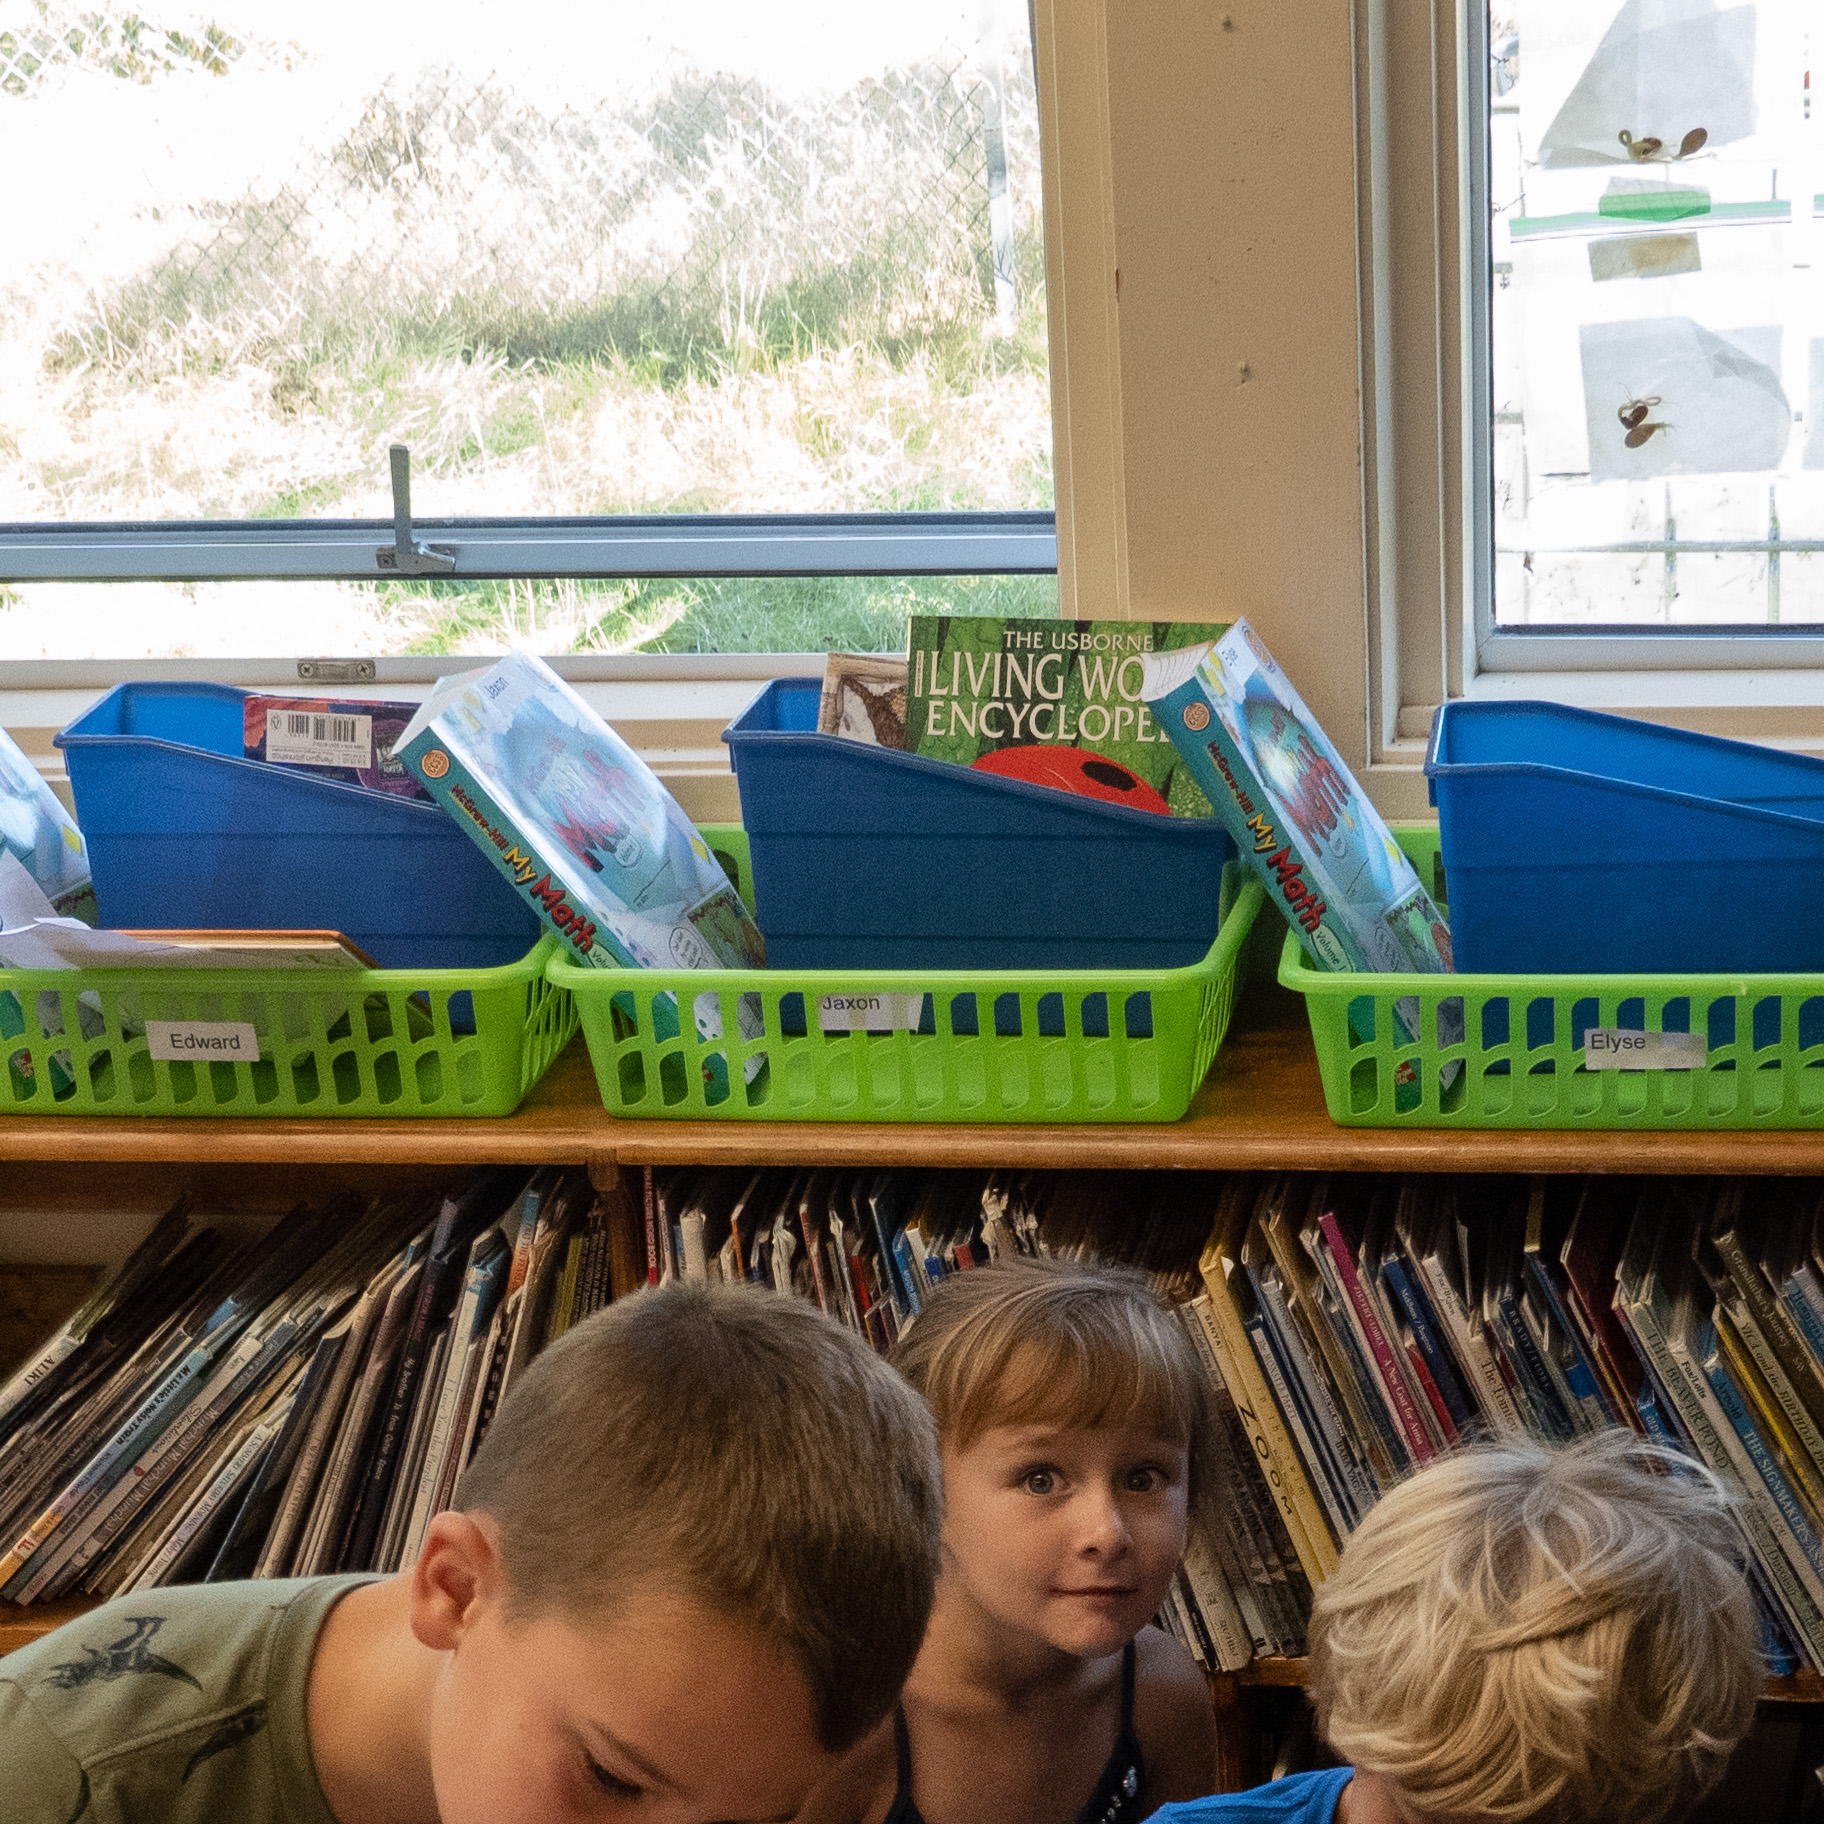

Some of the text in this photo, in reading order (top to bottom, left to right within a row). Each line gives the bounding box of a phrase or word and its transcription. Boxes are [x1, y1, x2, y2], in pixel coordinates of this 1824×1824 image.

[1004, 630, 1154, 651] THE USBORNE
[483, 676, 510, 700] Jaxon
[928, 650, 1064, 701] LIVING
[1206, 740, 1256, 815] McGraw-Hill
[1247, 811, 1278, 851] My
[1266, 846, 1327, 934] Math
[450, 783, 598, 956] McGraw-Hill My Math
[822, 993, 881, 1013] Jaxon
[168, 1031, 242, 1053] Edward
[1589, 1031, 1647, 1056] Elyse
[1727, 1246, 1793, 1351] Grandfather's Journey
[22, 1353, 56, 1386] ALIKI
[1478, 1357, 1501, 1386] The
[1678, 1357, 1710, 1402] Fox/Lofts
[114, 1375, 180, 1448] Little's Noisy Train
[370, 1355, 416, 1481] My Brother from Outer Space
[1385, 1366, 1428, 1446] New Coat for Anna
[1643, 1328, 1731, 1472] THE BEAVER POND
[1713, 1380, 1745, 1422] Arnold
[1754, 1350, 1820, 1450] and the BIRTHDAY
[429, 1434, 441, 1451] the
[1237, 1397, 1294, 1520] ZOOM
[204, 1468, 238, 1503] SATURDAY
[1741, 1428, 1814, 1544] THE SIGNMAKER'S
[178, 1499, 214, 1536] MORNING
